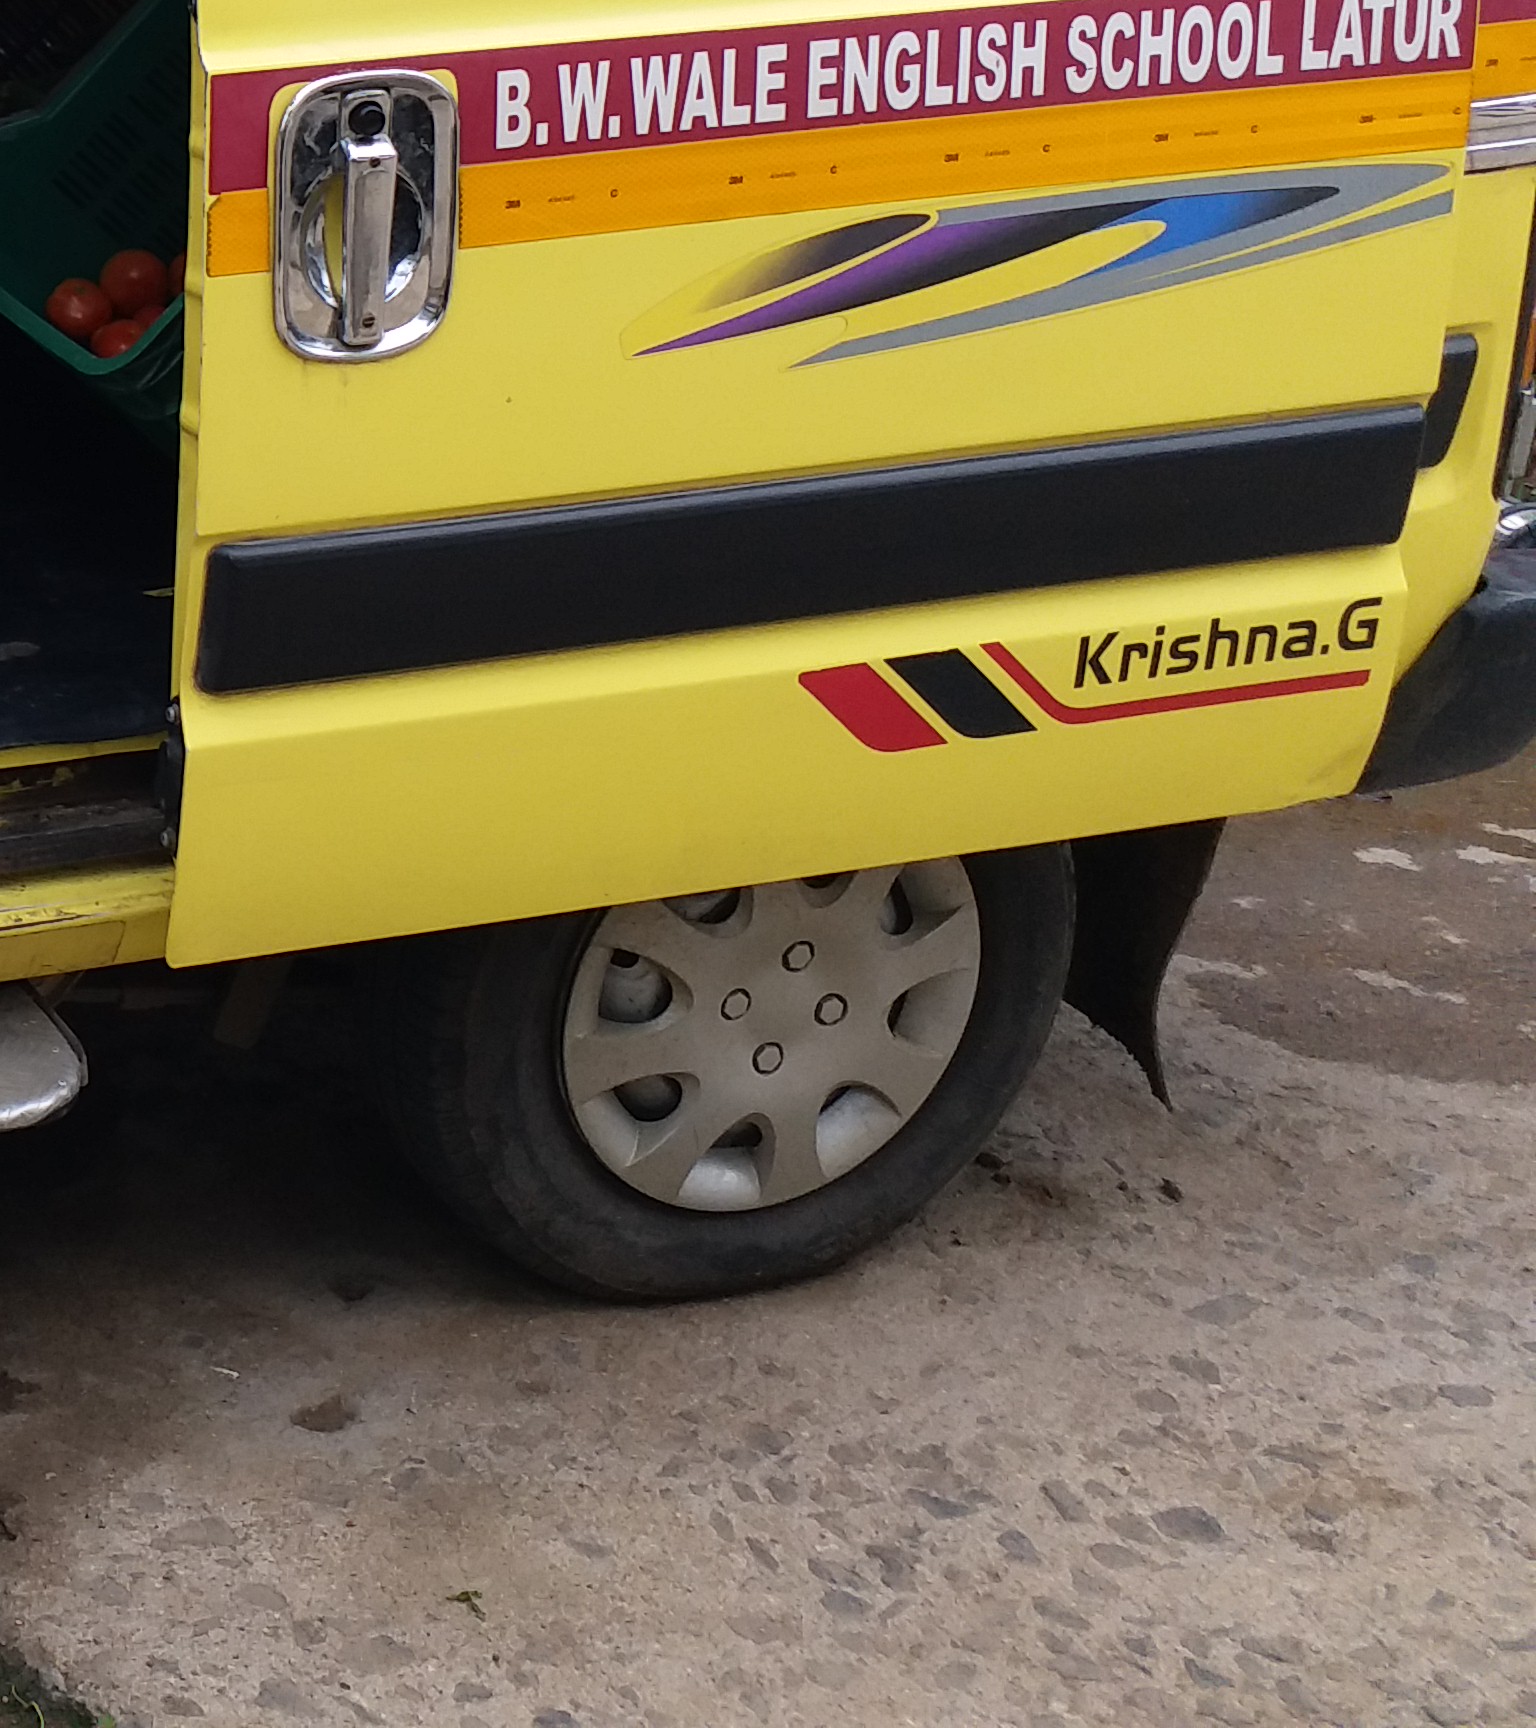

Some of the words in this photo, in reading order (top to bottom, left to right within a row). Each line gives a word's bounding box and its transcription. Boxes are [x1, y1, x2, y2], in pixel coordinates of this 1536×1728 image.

[806, 18, 1049, 120] ENGLISH
[1065, 0, 1285, 95] SCHOOL
[1072, 595, 1384, 691] Krishna.G
